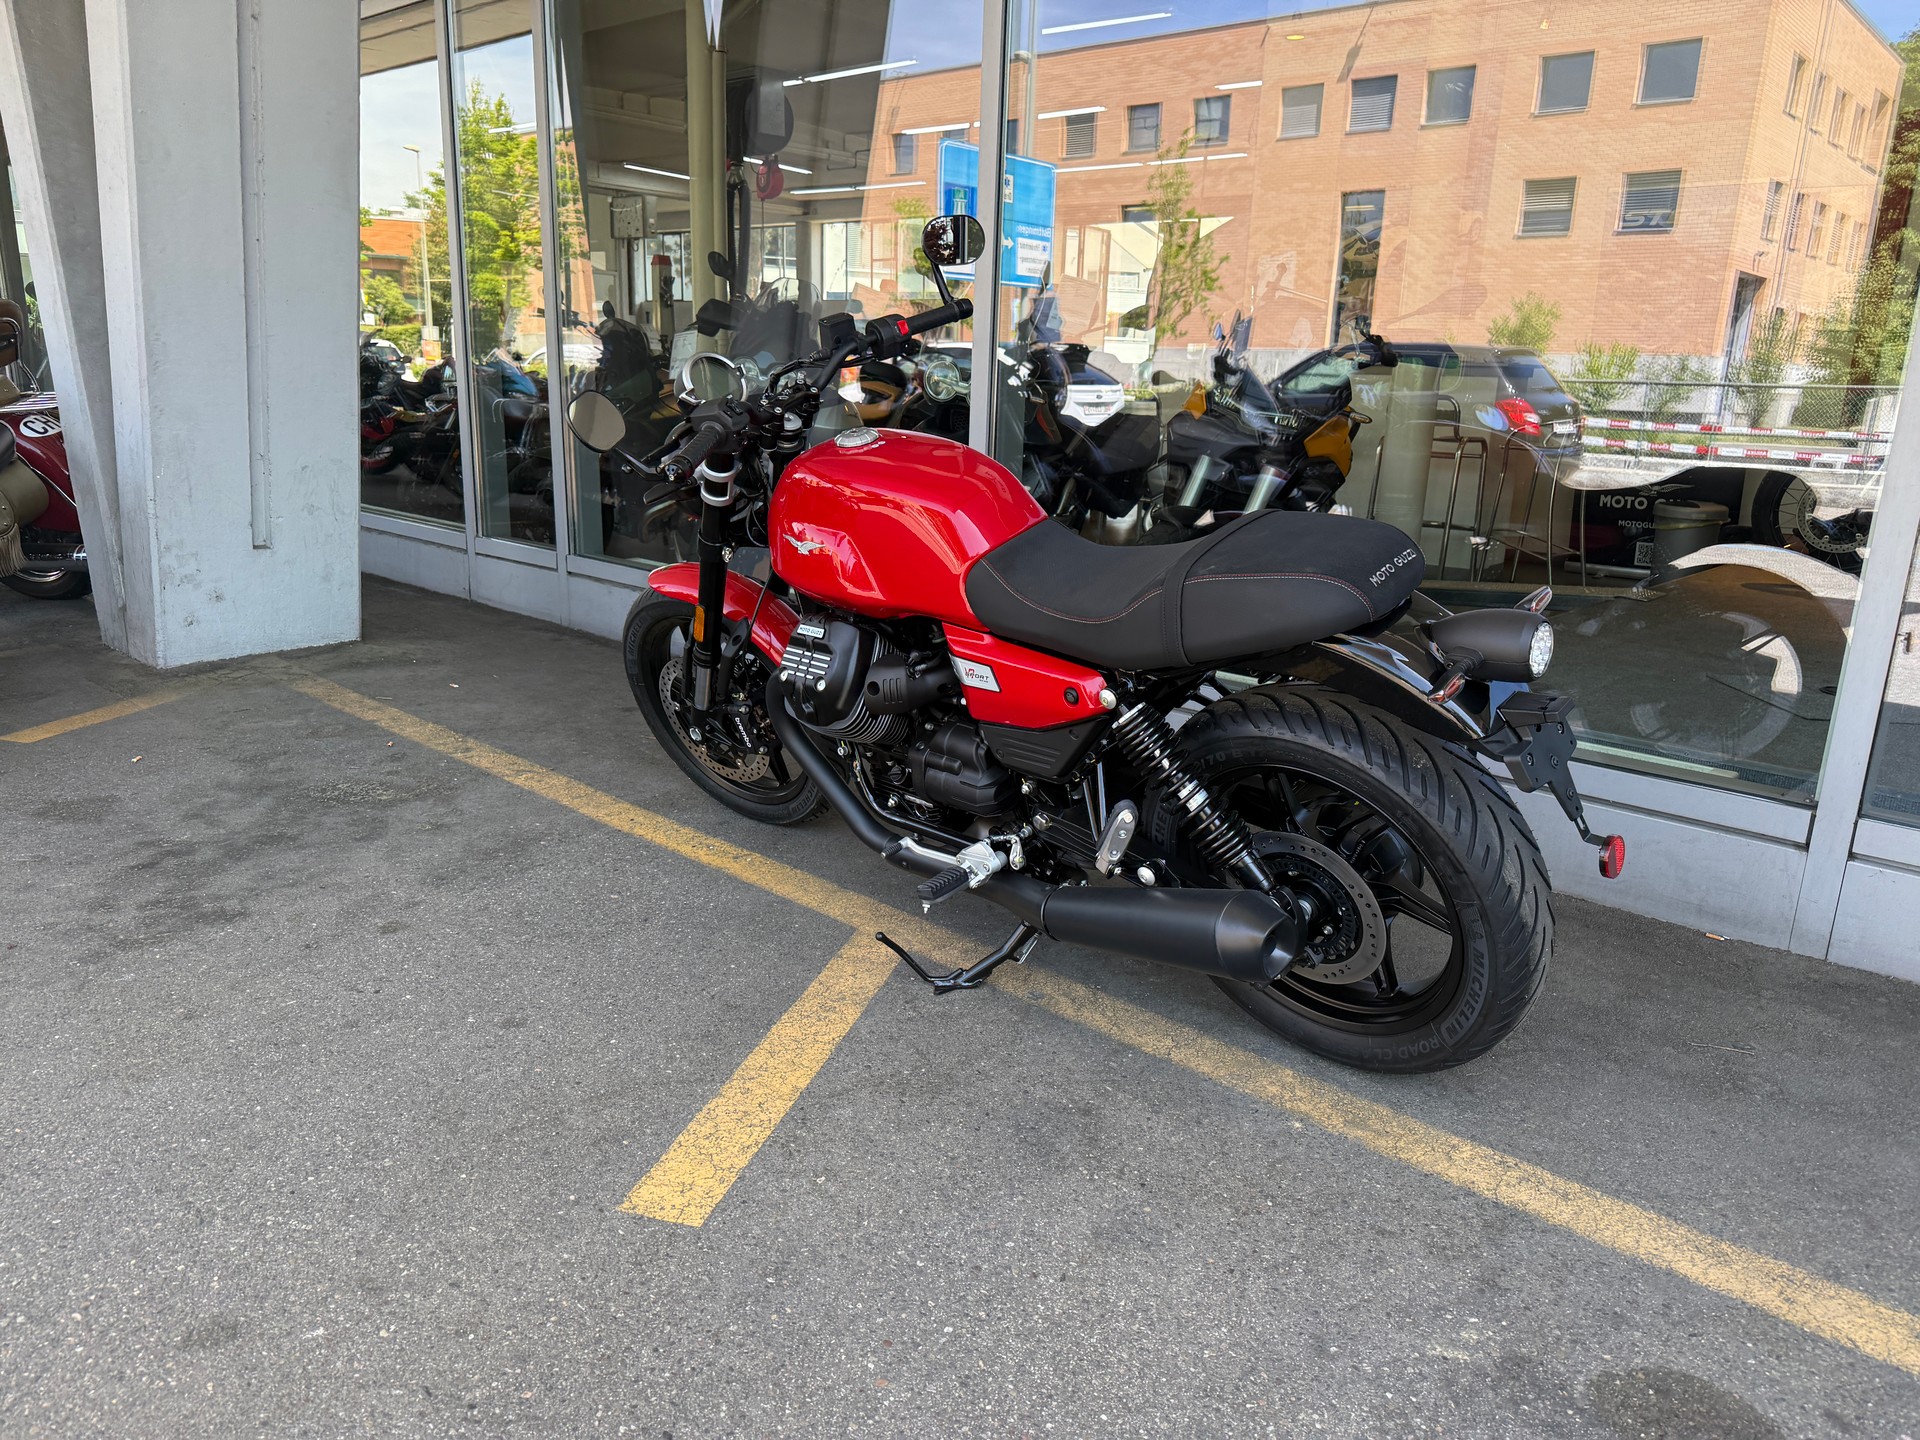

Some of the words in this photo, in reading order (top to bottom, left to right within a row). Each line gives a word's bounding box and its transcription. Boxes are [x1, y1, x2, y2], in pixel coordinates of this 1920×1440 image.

[23, 416, 61, 435] CH
[1599, 494, 1648, 510] MOTO
[1618, 519, 1655, 529] MOTOGU
[1369, 564, 1395, 587] MOTO
[1394, 548, 1417, 567] GUZZI
[735, 717, 752, 748] brembo
[1446, 949, 1487, 1043] MICHELIN
[1394, 1035, 1441, 1060] ROAD
